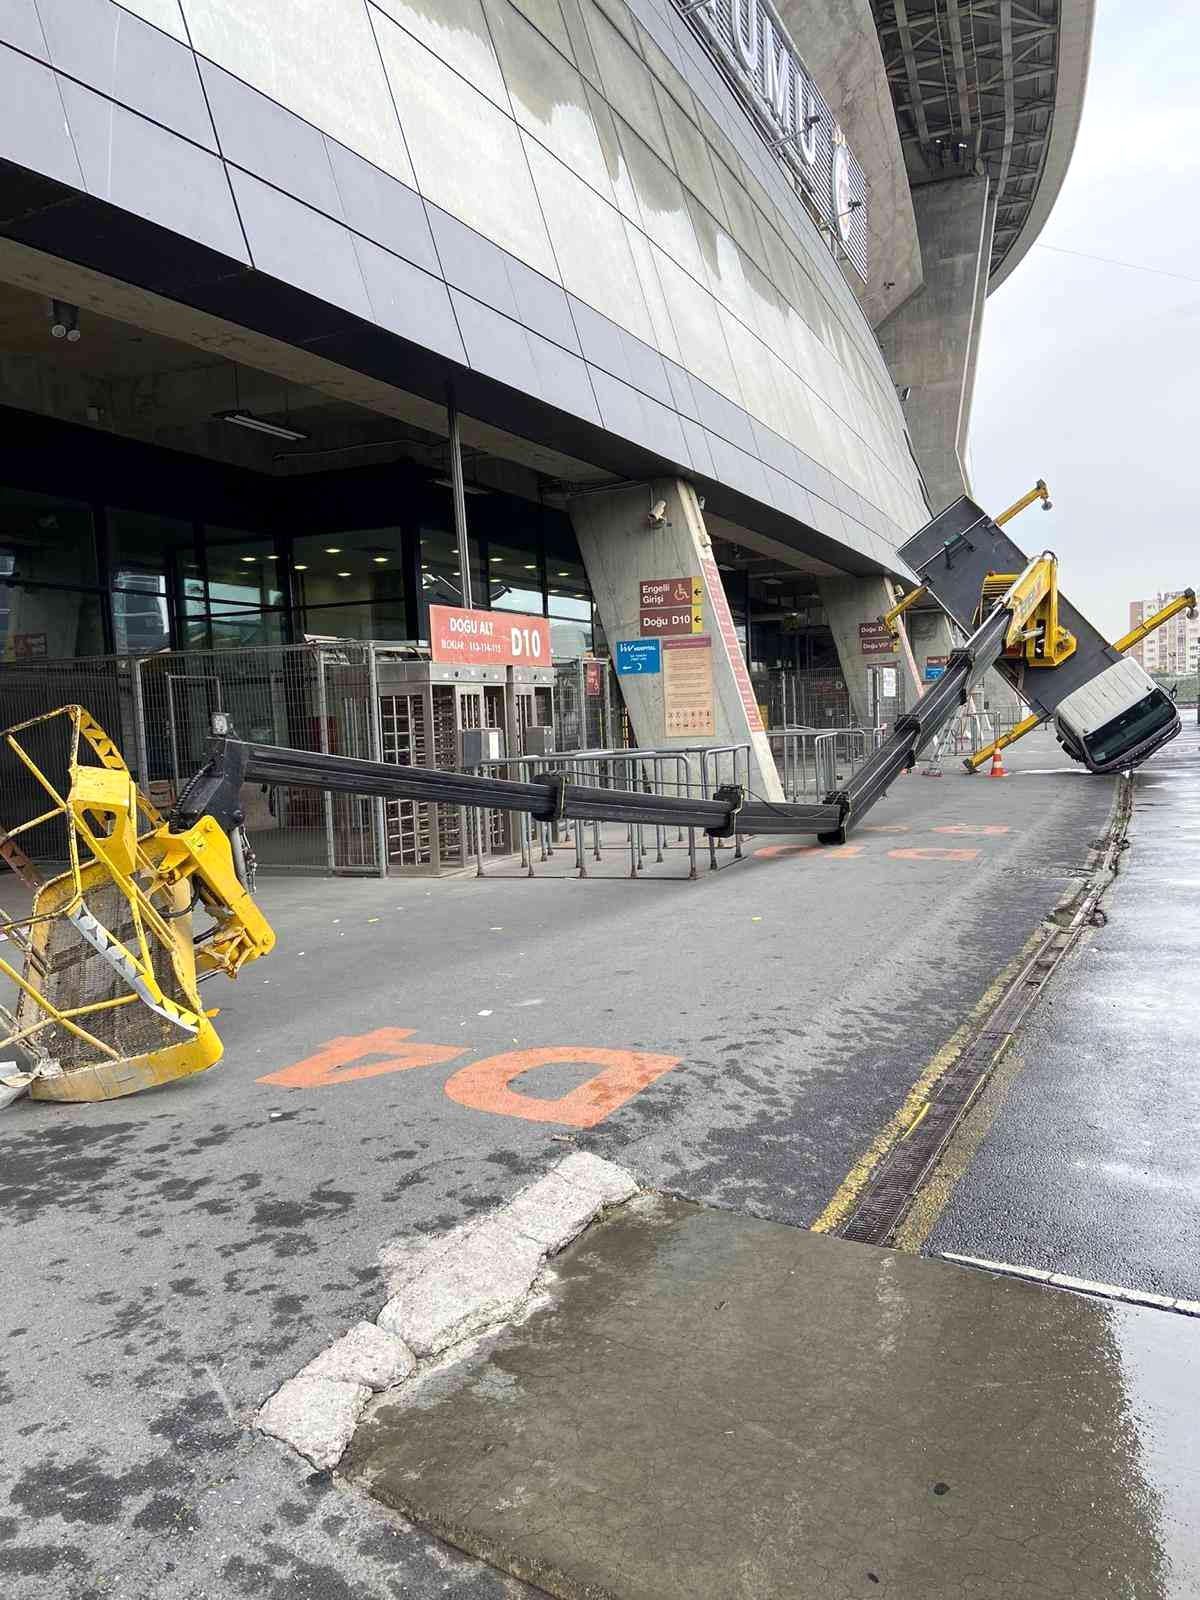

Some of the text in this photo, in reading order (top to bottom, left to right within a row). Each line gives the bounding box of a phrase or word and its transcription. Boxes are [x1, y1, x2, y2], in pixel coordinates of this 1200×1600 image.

[642, 584, 670, 594] Engelli
[642, 595, 664, 605] Girişi
[449, 617, 494, 637] DOĞU ALT
[643, 614, 690, 628] Doğu D10
[511, 627, 541, 658] D10
